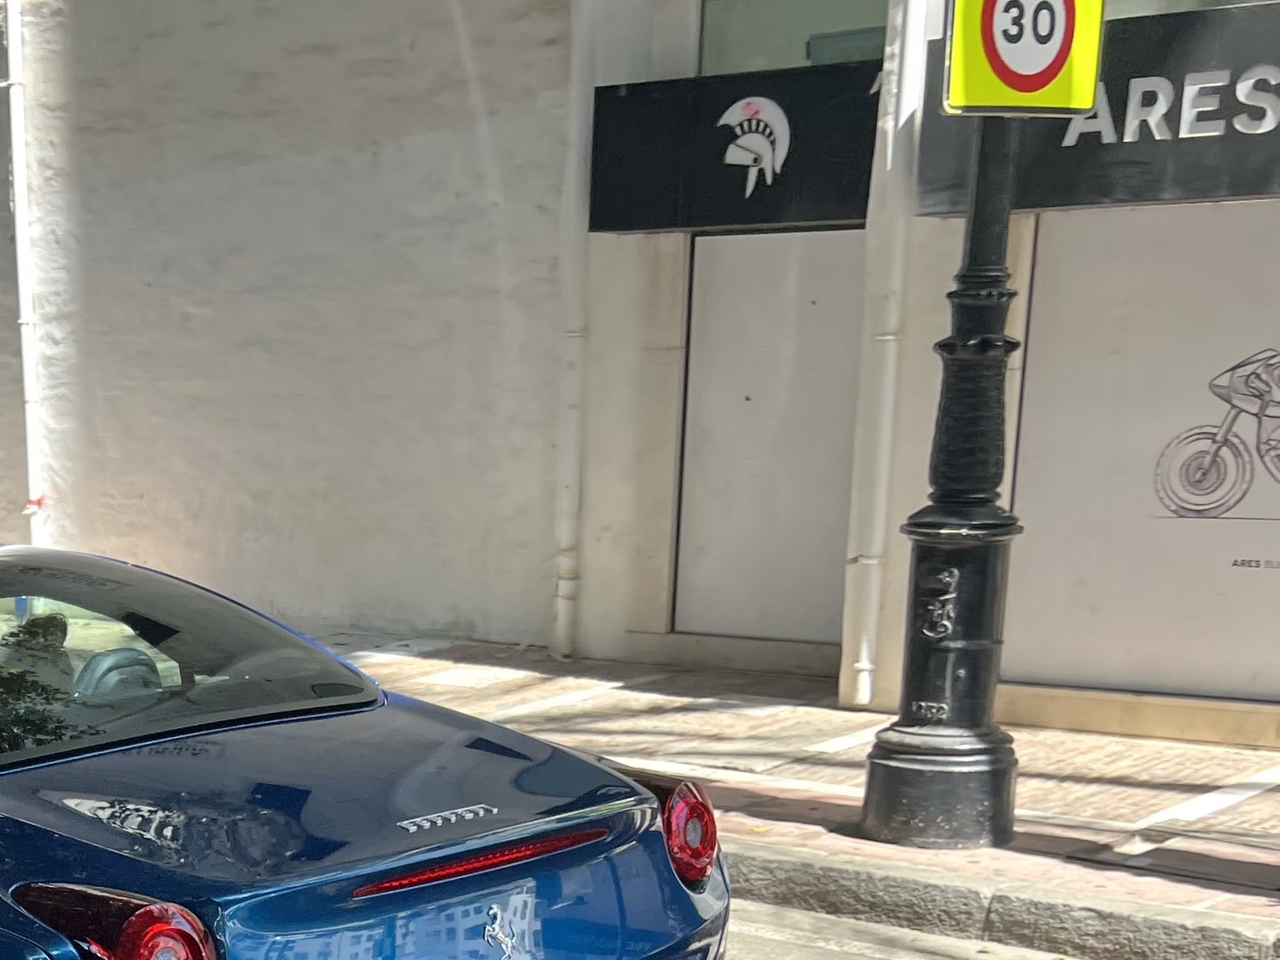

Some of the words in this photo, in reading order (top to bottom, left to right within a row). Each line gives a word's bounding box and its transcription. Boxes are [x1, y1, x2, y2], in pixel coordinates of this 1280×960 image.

[1002, 0, 1055, 45] 30
[1061, 64, 1280, 147] ARES
[1231, 559, 1261, 569] ARES
